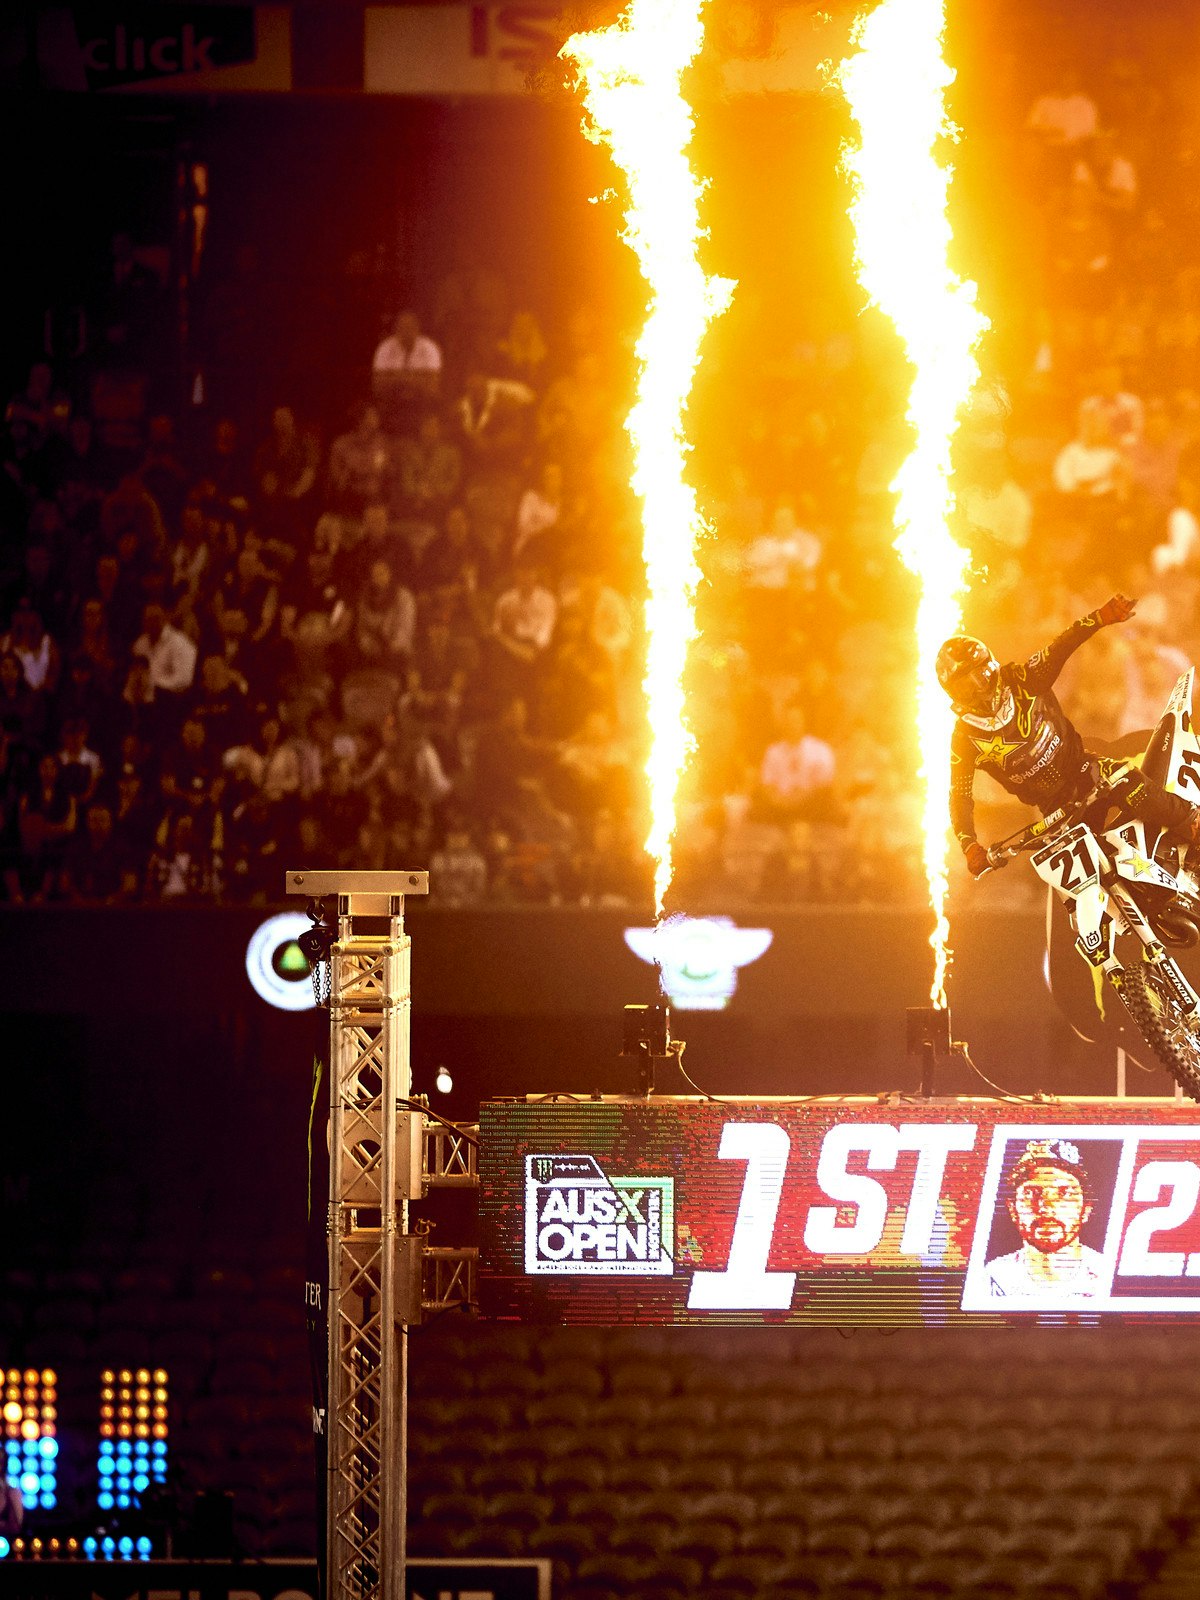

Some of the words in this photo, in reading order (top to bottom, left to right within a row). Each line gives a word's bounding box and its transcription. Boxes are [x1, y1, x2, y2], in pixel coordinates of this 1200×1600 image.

[83, 22, 218, 72] click
[1049, 837, 1097, 891] 21
[1162, 963, 1194, 1005] DUNLOP
[538, 1223, 648, 1260] OPEN
